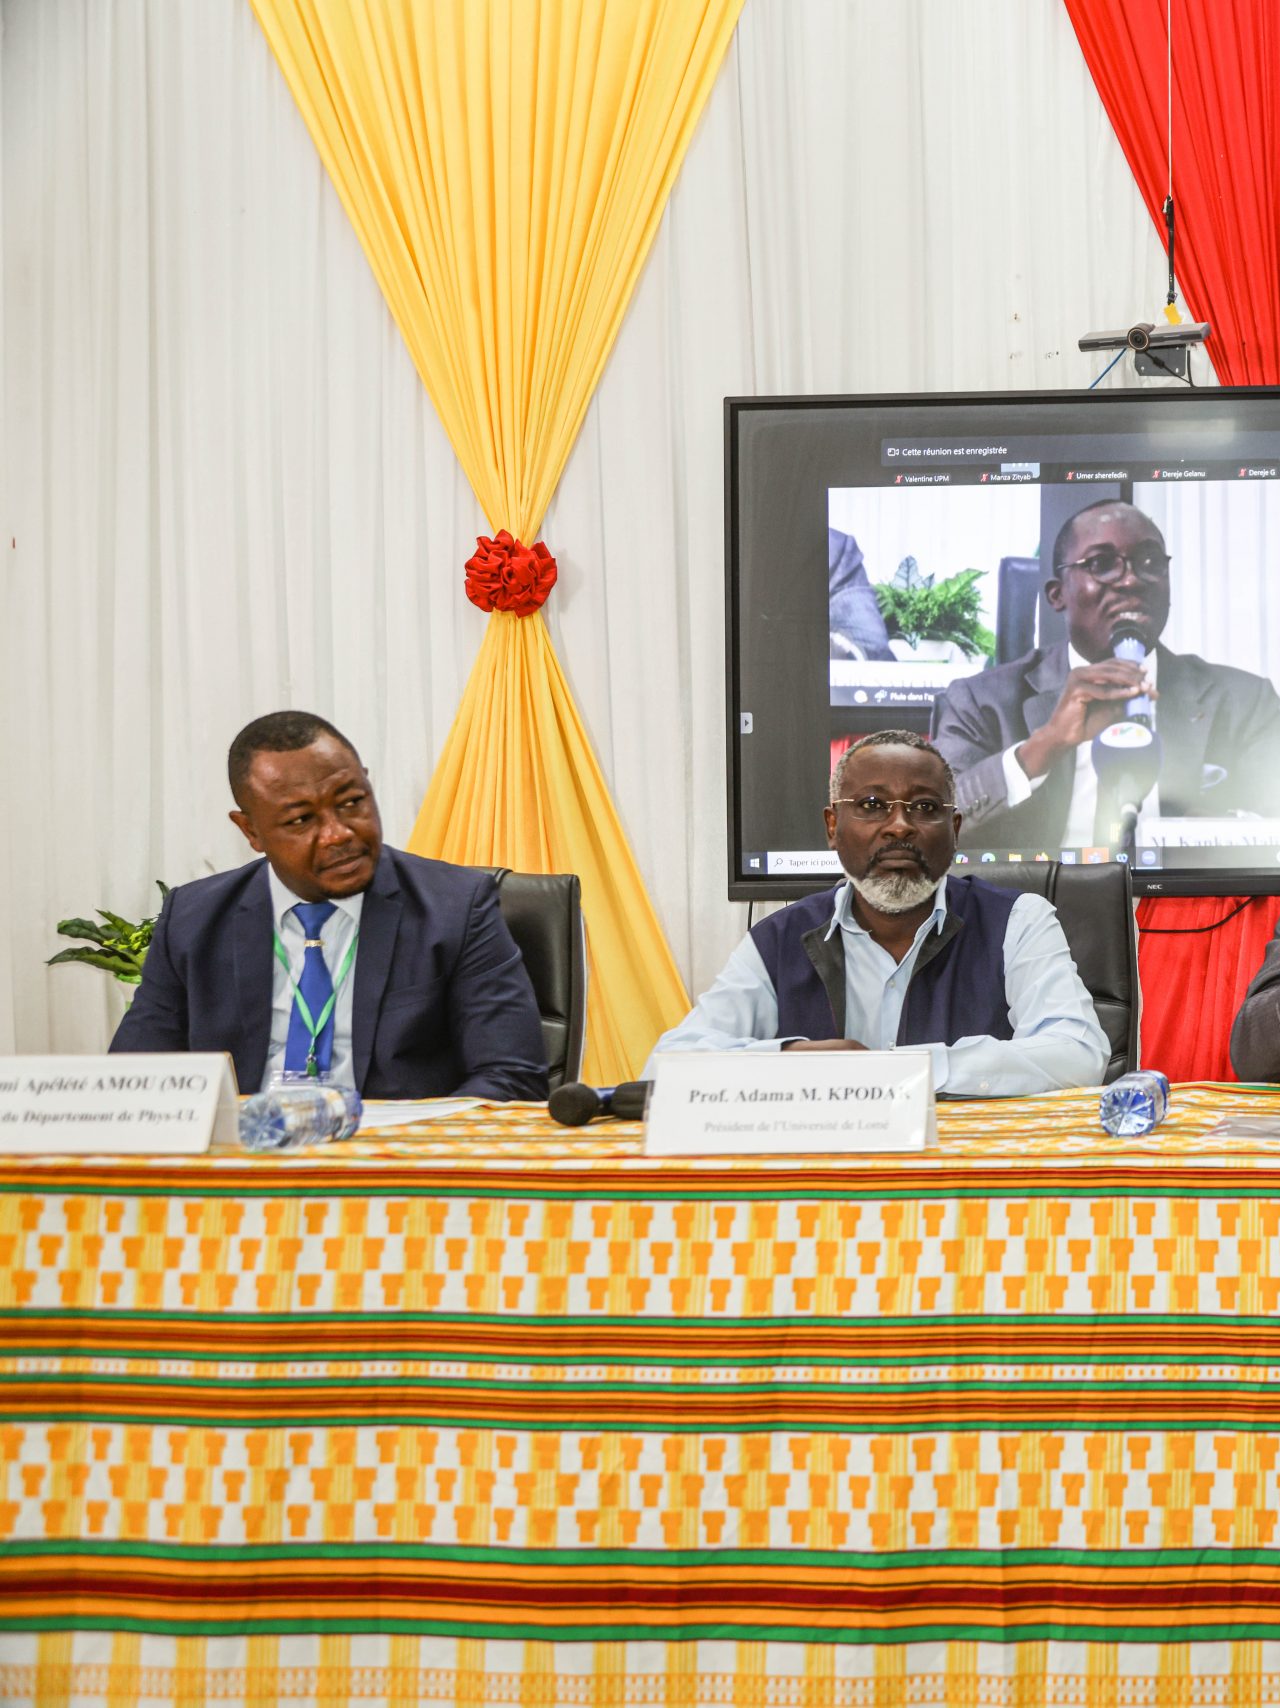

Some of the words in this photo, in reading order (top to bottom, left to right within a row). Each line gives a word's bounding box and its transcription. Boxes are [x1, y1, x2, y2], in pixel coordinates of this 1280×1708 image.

[902, 447, 922, 456] Cette
[923, 447, 952, 456] réunion
[953, 447, 965, 456] est
[966, 446, 1008, 456] enregistrée
[1162, 470, 1183, 479] Dereje
[1248, 468, 1269, 477] Dereje
[904, 474, 933, 483] Valentine
[933, 474, 950, 482] UPM
[789, 858, 808, 868] Taper
[810, 858, 819, 866] ici
[820, 859, 838, 867] pour
[23, 1075, 89, 1097] Apélété
[91, 1075, 158, 1091] AMOU
[160, 1074, 208, 1095] (MC)
[689, 1087, 729, 1104] Prof.
[734, 1087, 794, 1103] Adama
[800, 1087, 822, 1101] M.
[828, 1086, 911, 1101] KPODA
[22, 1109, 113, 1127] Département
[117, 1109, 134, 1122] de
[703, 1119, 755, 1134] Président
[756, 1119, 771, 1133] de
[840, 1118, 854, 1131] de
[857, 1118, 891, 1131] Lomé
